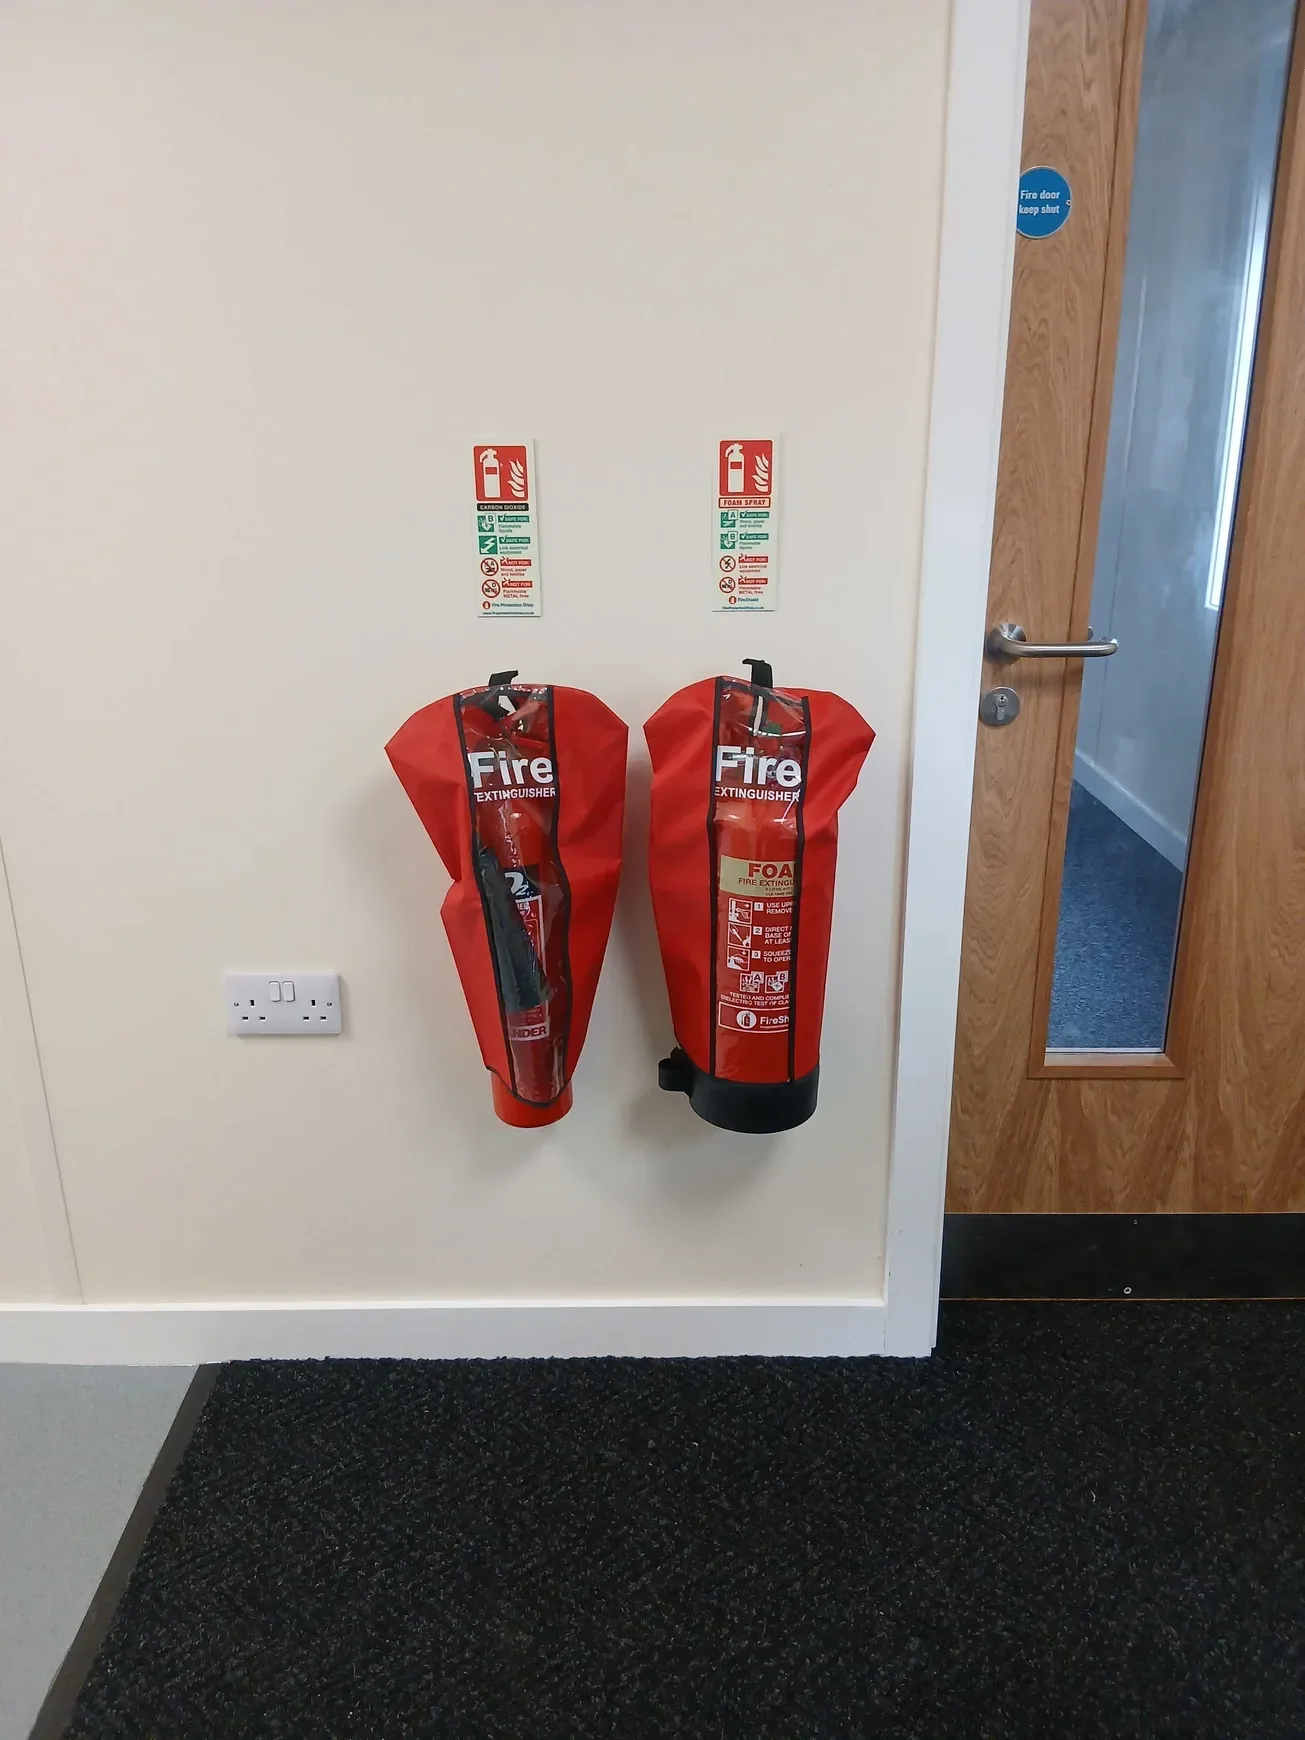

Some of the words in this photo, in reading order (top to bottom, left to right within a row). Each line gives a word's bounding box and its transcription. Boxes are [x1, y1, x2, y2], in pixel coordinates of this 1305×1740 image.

[1020, 190, 1038, 199] Fire
[1040, 190, 1060, 199] door
[1019, 204, 1039, 216] keep
[1041, 204, 1060, 214] shut
[468, 751, 554, 788] Fire
[716, 745, 801, 787] Fire
[474, 788, 556, 802] EXTINGUISHER
[715, 787, 800, 802] EXTINGUISHER
[748, 863, 795, 878] FOA
[730, 992, 750, 1000] TESTED
[760, 1015, 789, 1025] FireSh
